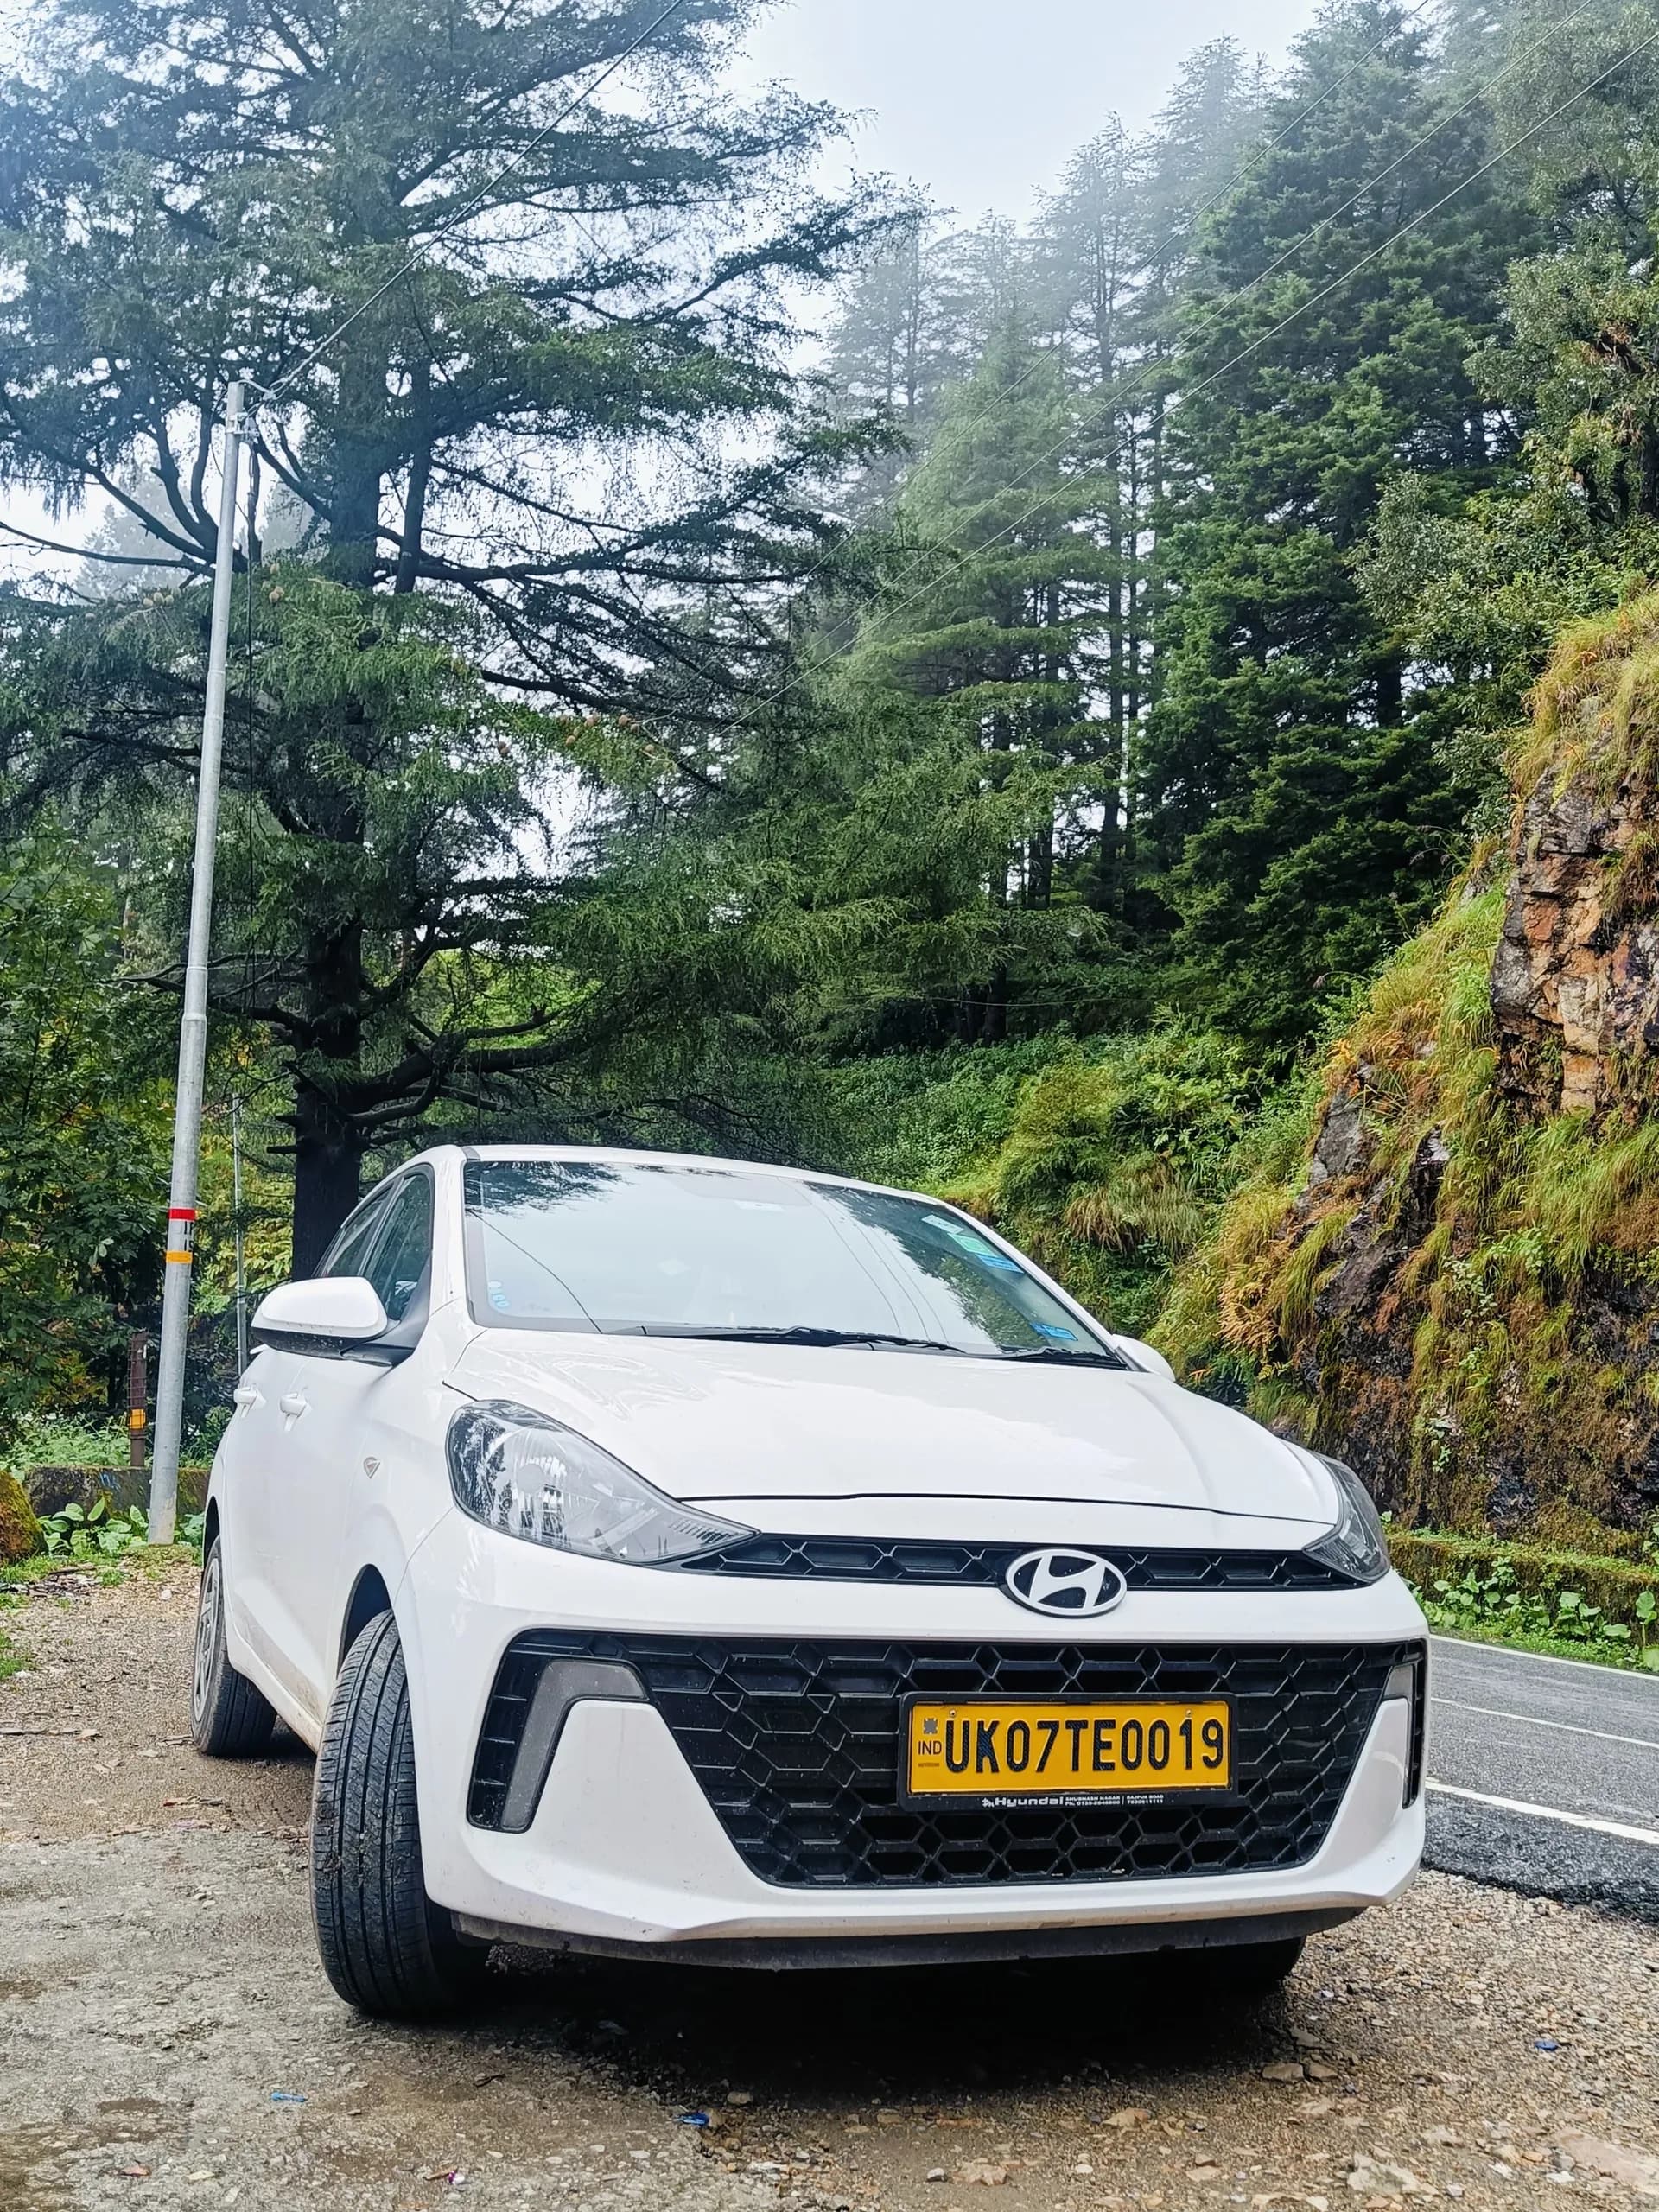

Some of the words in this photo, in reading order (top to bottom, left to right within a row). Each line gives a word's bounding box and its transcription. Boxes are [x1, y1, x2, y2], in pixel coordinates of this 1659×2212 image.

[918, 1740, 943, 1756] IND
[945, 1719, 1224, 1774] UK07TE0019
[995, 1796, 1064, 1807] Hyundai
